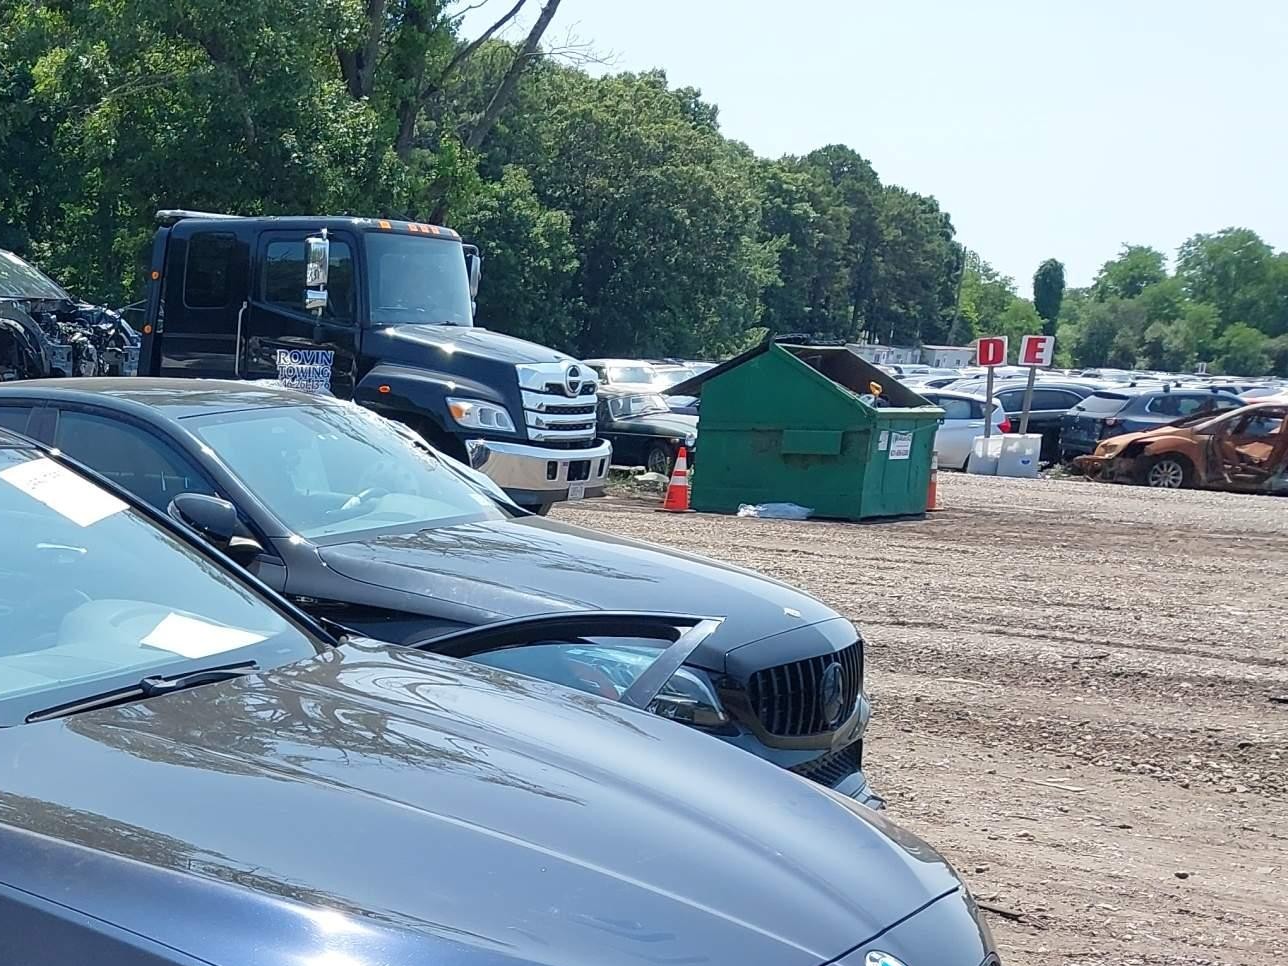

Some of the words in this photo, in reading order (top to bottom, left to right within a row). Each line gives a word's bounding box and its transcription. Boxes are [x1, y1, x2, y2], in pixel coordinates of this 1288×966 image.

[277, 350, 334, 365] ROVIN
[979, 339, 1004, 365] D
[1024, 338, 1047, 363] E
[278, 365, 332, 379] TOWING
